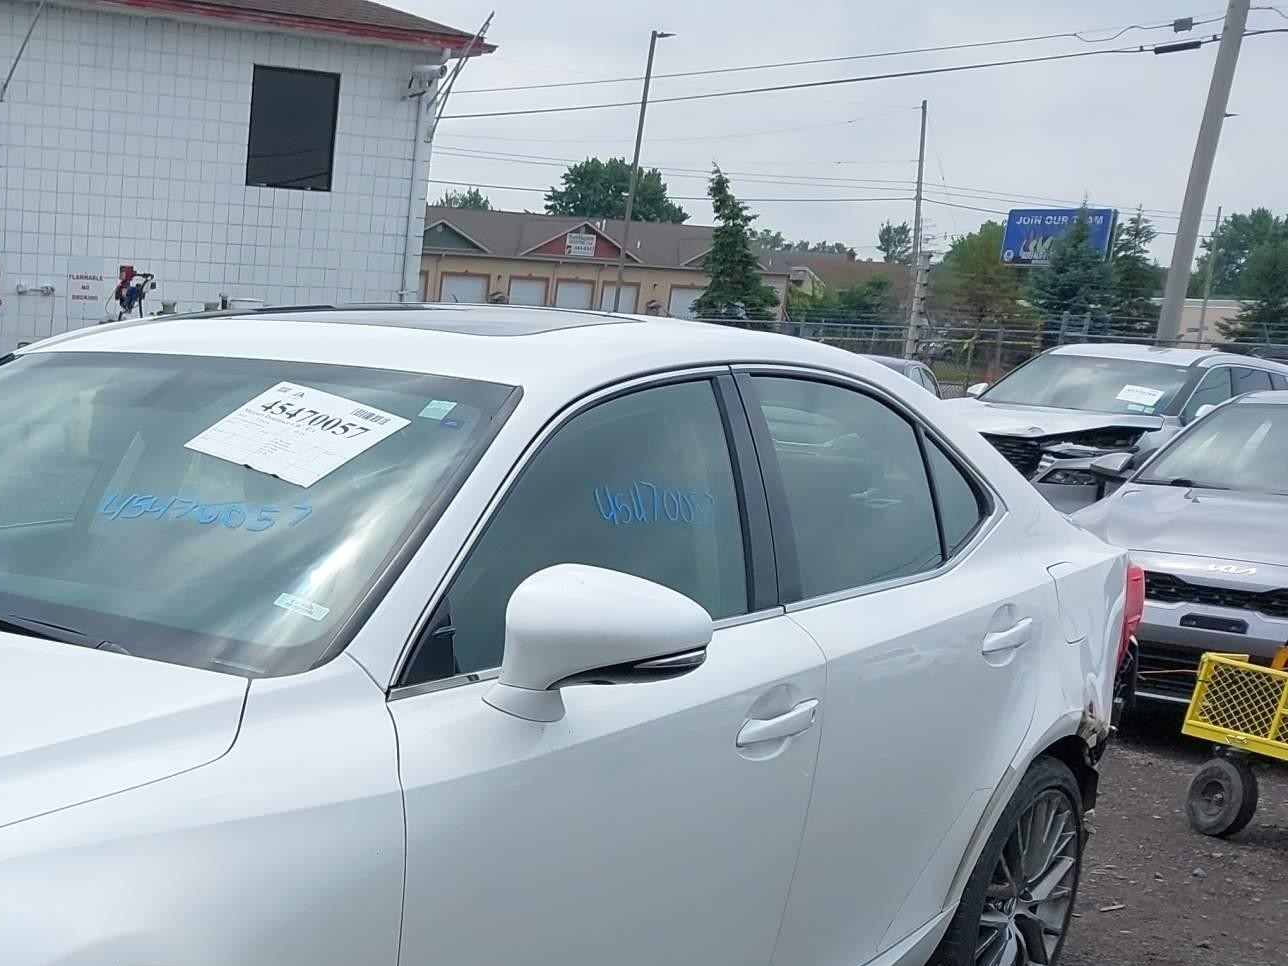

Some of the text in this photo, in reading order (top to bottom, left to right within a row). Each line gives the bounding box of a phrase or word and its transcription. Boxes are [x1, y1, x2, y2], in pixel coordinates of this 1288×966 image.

[1016, 215, 1042, 225] JOIN
[1045, 215, 1068, 225] OUR
[261, 400, 371, 439] 45470057
[98, 493, 313, 532] 45470057
